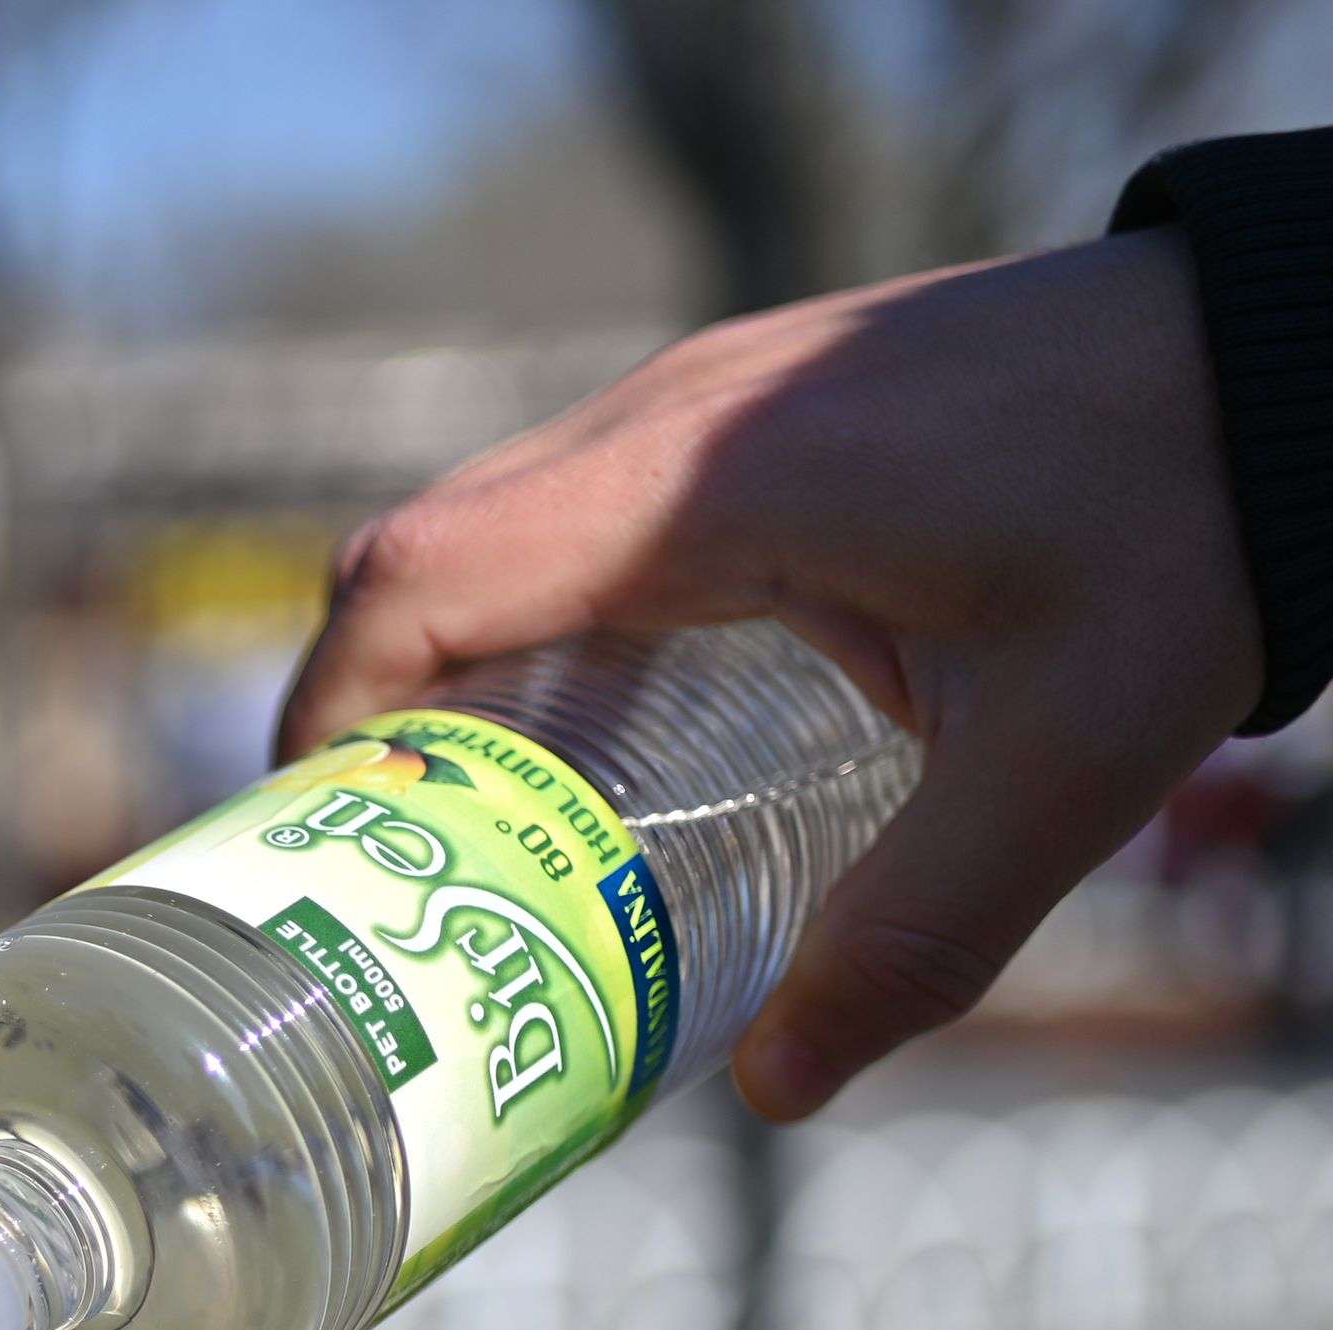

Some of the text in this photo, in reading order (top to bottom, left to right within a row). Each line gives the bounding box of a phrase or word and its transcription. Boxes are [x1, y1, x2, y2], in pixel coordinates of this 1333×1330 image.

[275, 919, 407, 1077] PET BOTTLE
[336, 938, 405, 1014] 500ml
[617, 869, 670, 1075] ANDALİNA
